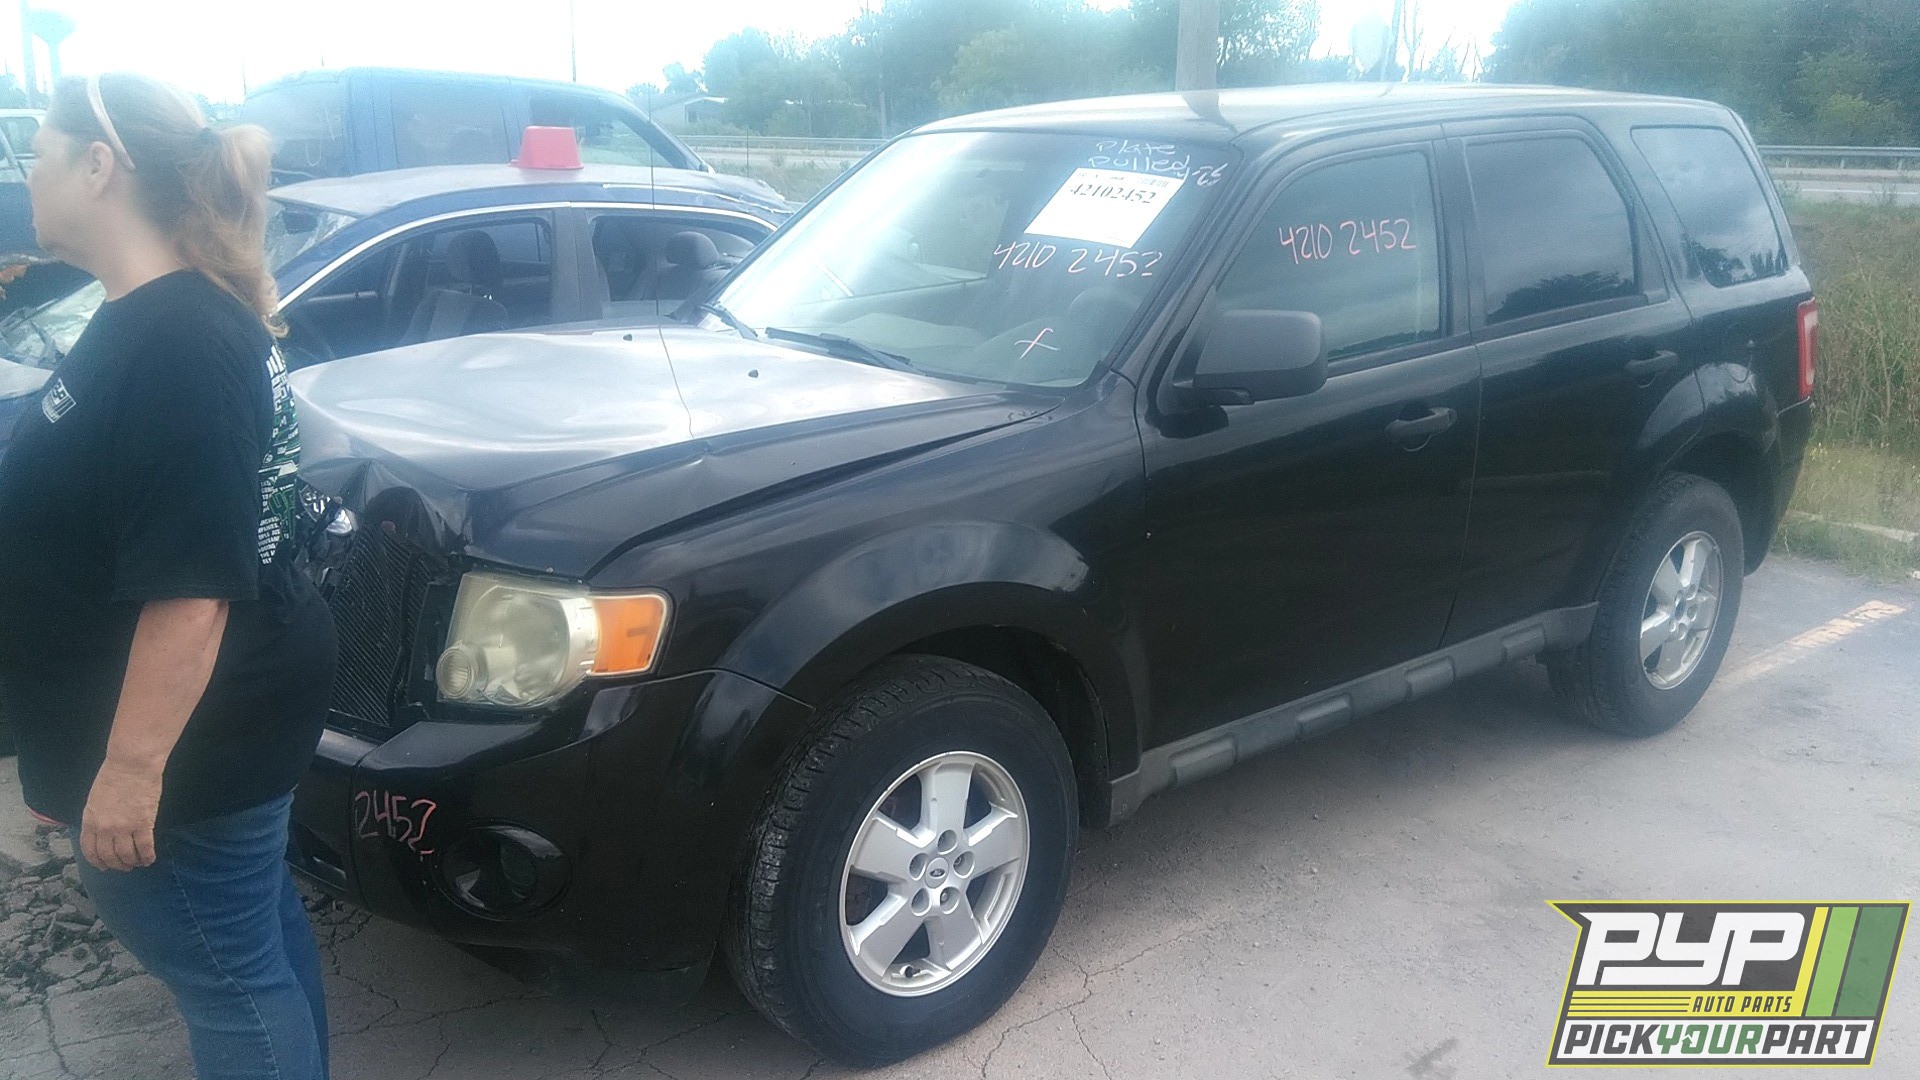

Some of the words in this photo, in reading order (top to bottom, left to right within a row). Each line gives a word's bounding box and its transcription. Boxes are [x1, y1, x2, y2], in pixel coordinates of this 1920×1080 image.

[1069, 183, 1157, 204] 42102452
[993, 241, 1057, 270] 4210
[1067, 248, 1163, 278] 2452
[1279, 223, 1333, 265] 4210
[1340, 218, 1417, 255] 2452
[354, 789, 437, 856] 2452
